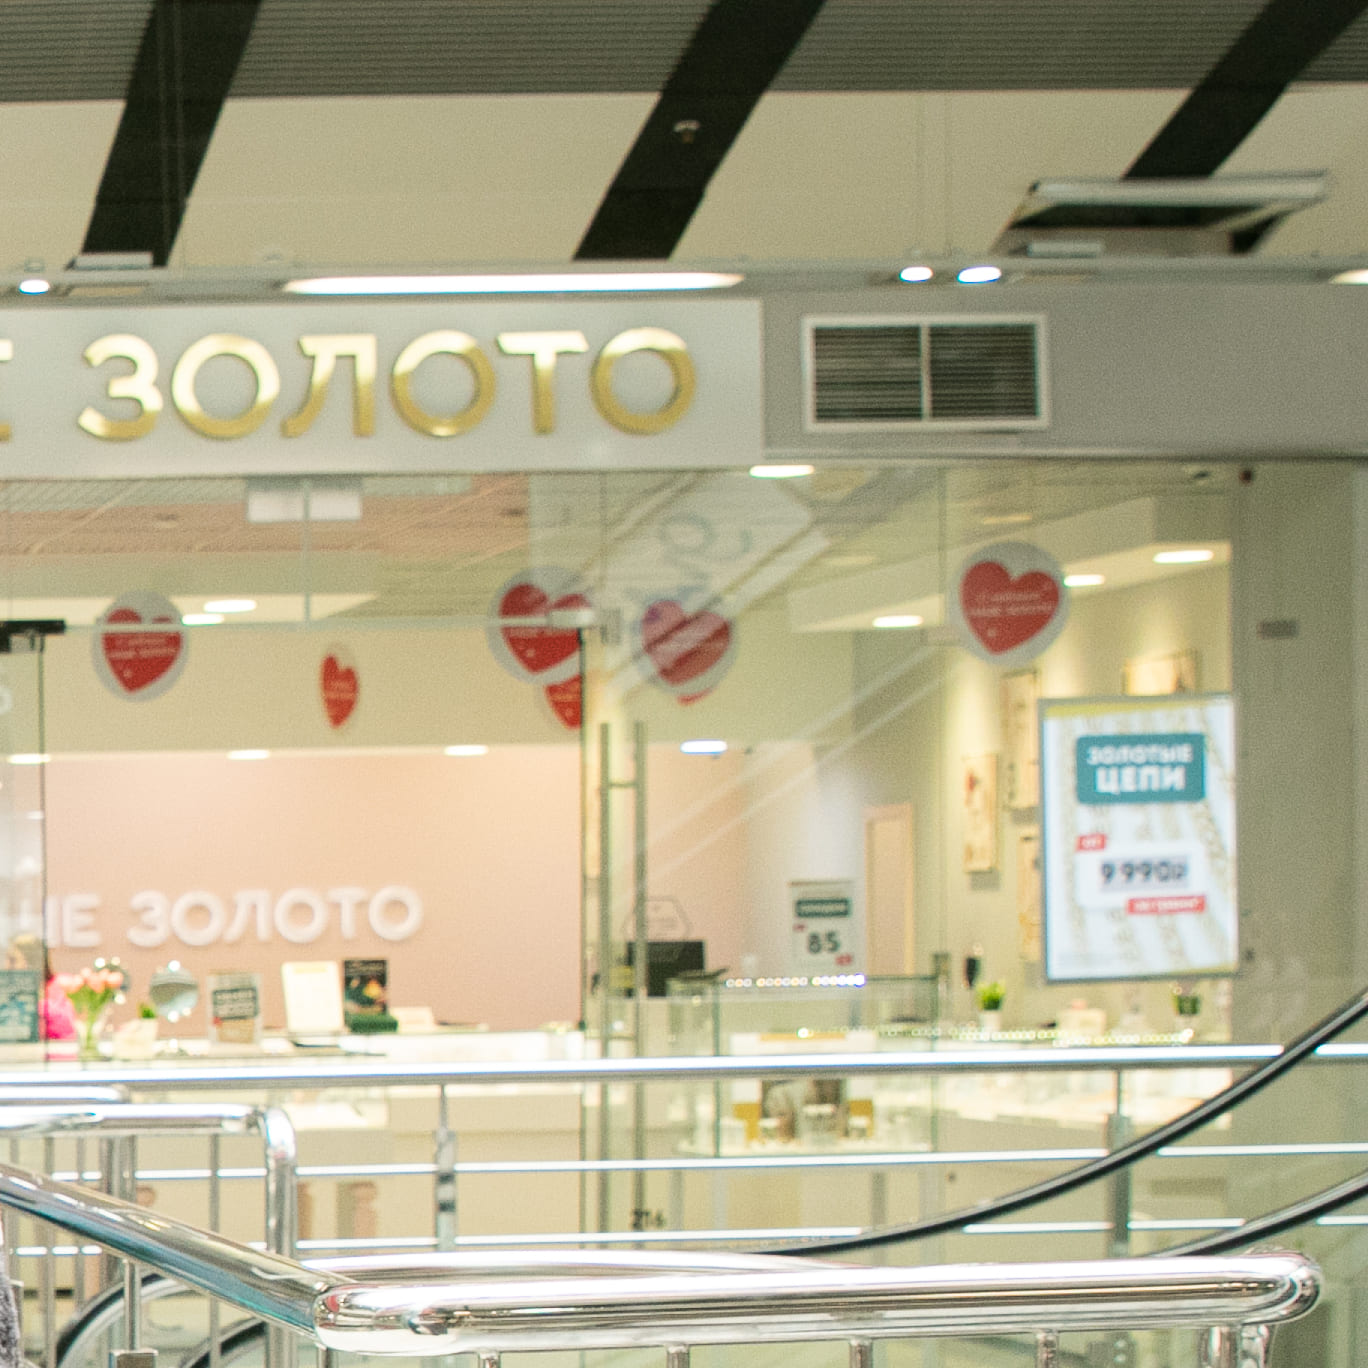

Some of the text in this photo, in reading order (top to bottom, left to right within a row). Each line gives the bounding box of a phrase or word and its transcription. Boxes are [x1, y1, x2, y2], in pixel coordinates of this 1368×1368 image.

[78, 327, 697, 441] ЗОЛОТО
[1097, 766, 1185, 794] ЦЕПИ
[127, 885, 423, 947] ЗОЛОТО
